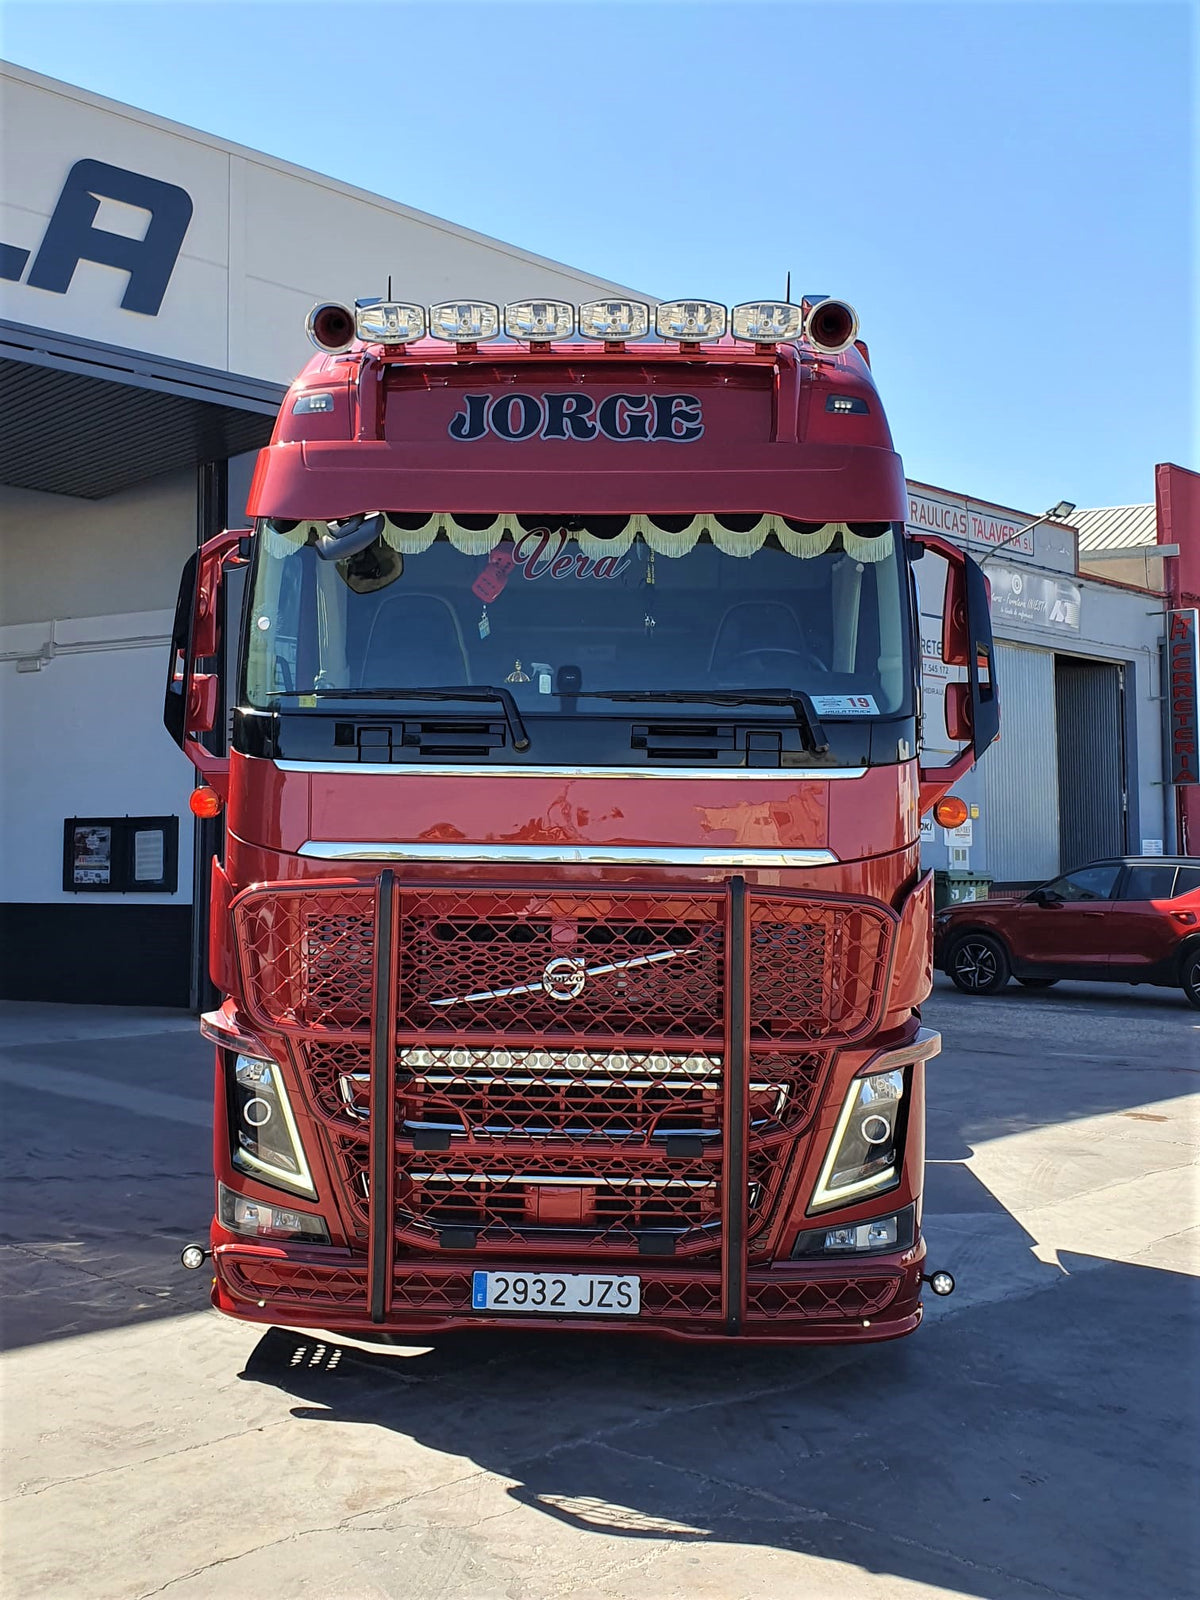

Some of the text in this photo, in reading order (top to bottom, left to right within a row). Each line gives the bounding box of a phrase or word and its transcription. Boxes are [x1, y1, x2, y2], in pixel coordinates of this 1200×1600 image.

[448, 392, 704, 442] JORGE
[971, 517, 1021, 548] TALAVERA
[512, 527, 631, 580] Vera
[846, 697, 870, 707] 19
[1172, 643, 1196, 782] FERRETERIA
[477, 1277, 632, 1308] E 2932 JZS
